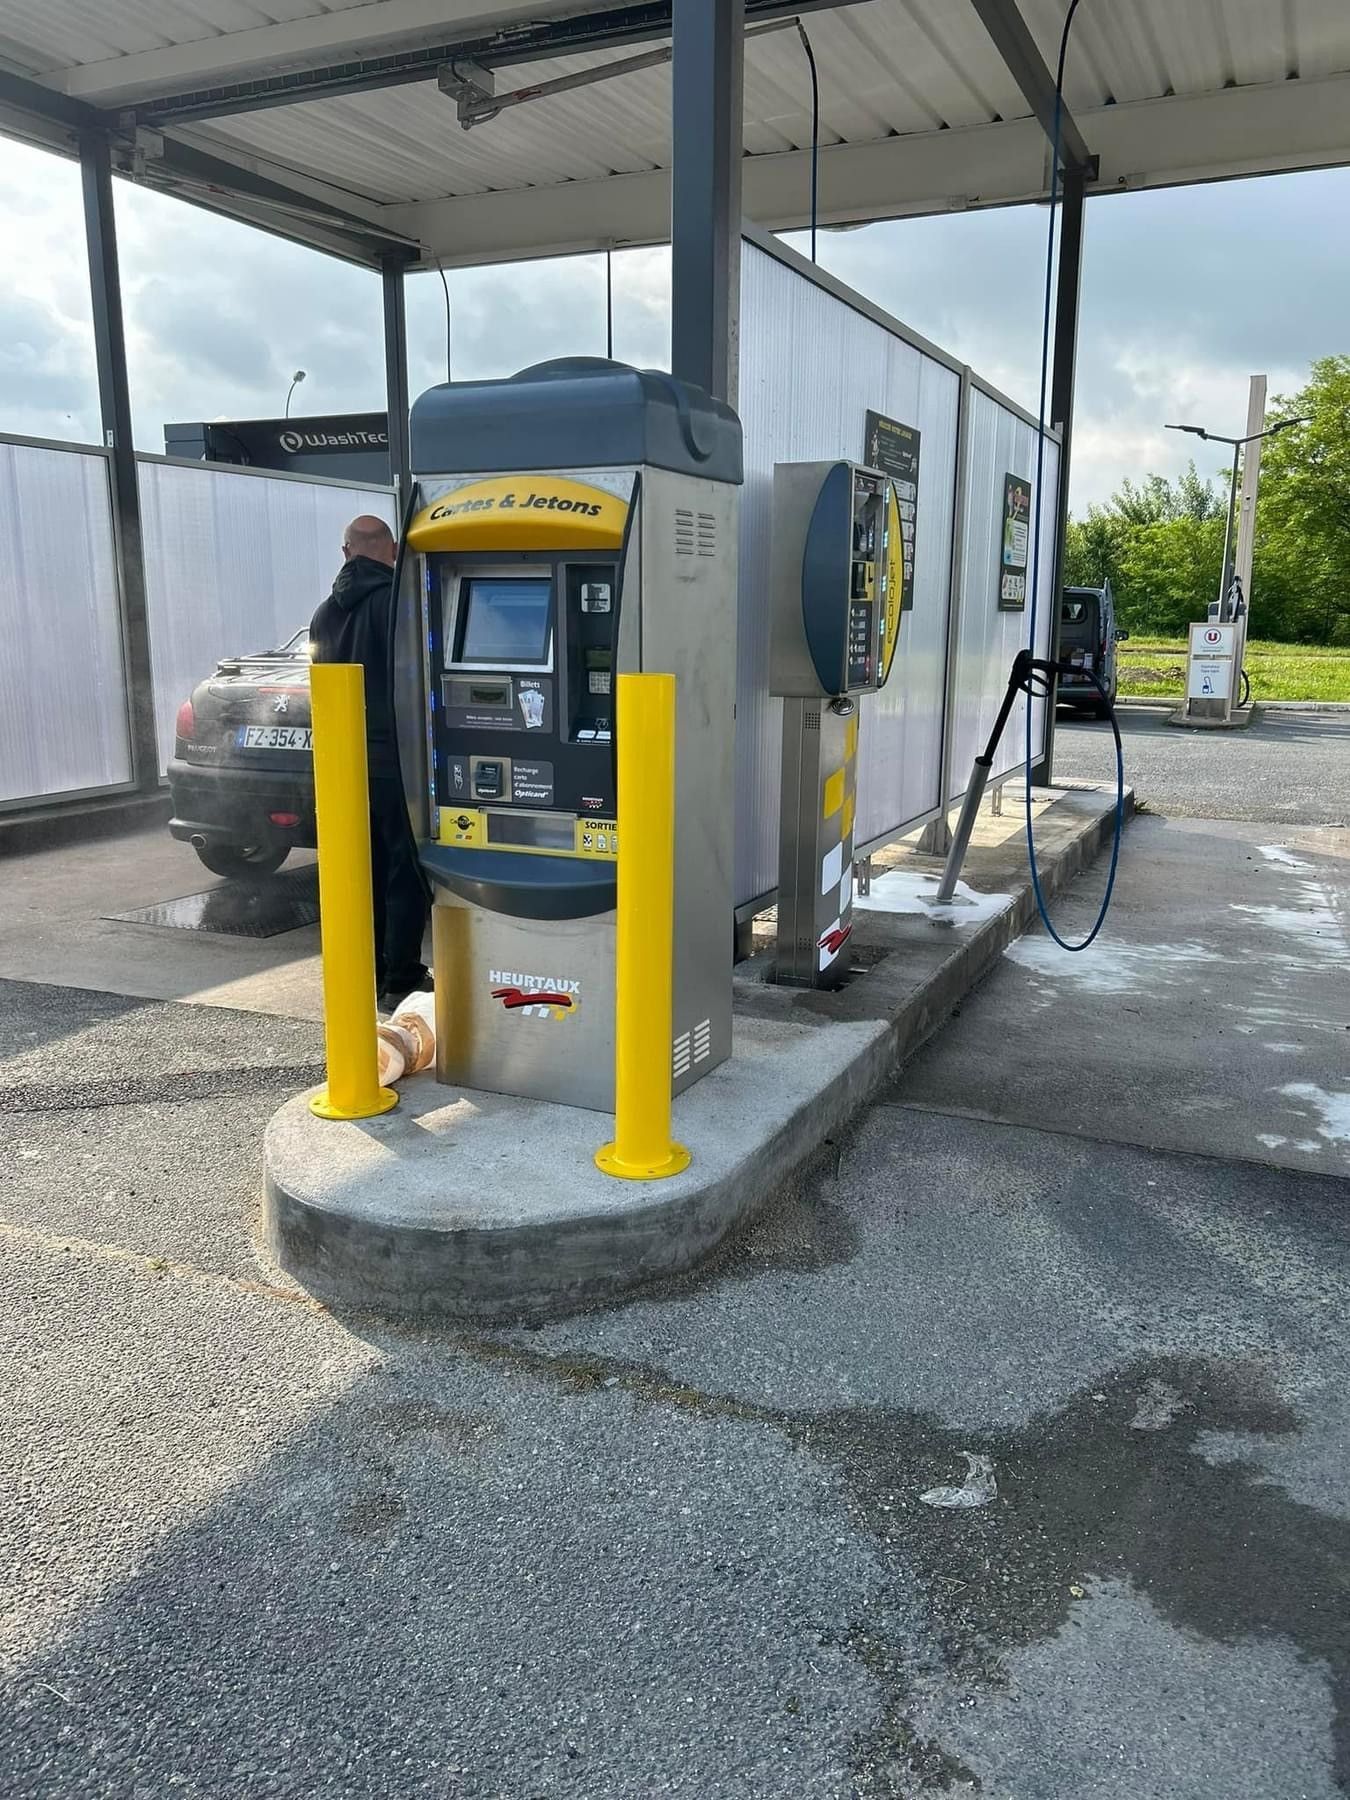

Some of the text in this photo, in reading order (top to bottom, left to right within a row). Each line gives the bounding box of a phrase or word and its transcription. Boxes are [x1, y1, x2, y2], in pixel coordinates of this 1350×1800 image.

[304, 431, 389, 446] WashTec
[430, 494, 602, 520] Cartes & Jetons
[520, 681, 540, 689] Billets
[246, 728, 314, 748] FZ-354-X
[187, 744, 217, 753] PEUGEOT
[585, 821, 617, 831] SORTIE
[489, 970, 580, 994] HEURTAUX
